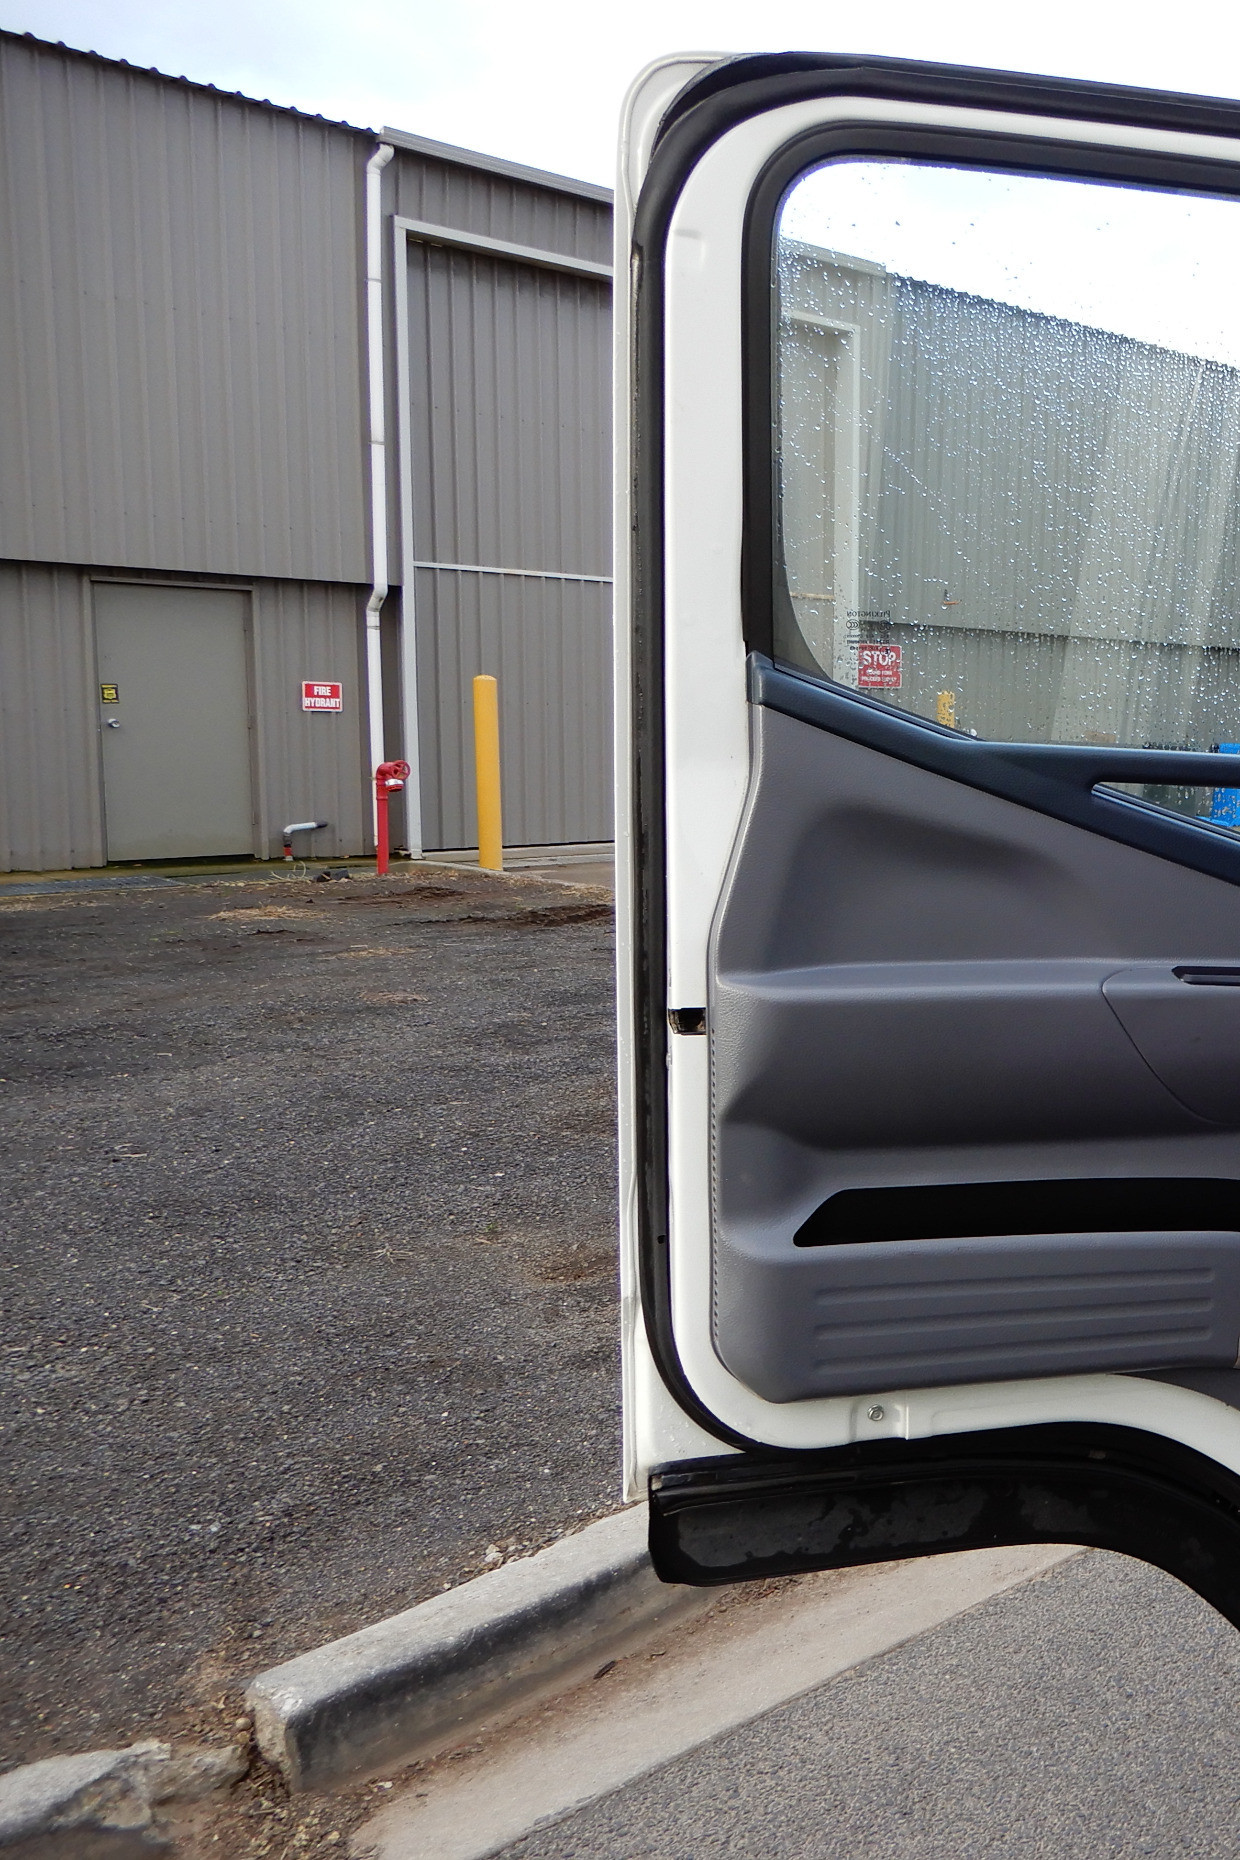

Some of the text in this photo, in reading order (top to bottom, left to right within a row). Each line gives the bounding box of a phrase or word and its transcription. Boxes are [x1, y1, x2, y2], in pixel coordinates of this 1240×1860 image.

[863, 651, 896, 665] STOP
[313, 685, 332, 696] FIRE
[304, 697, 340, 708] HYDRANT
